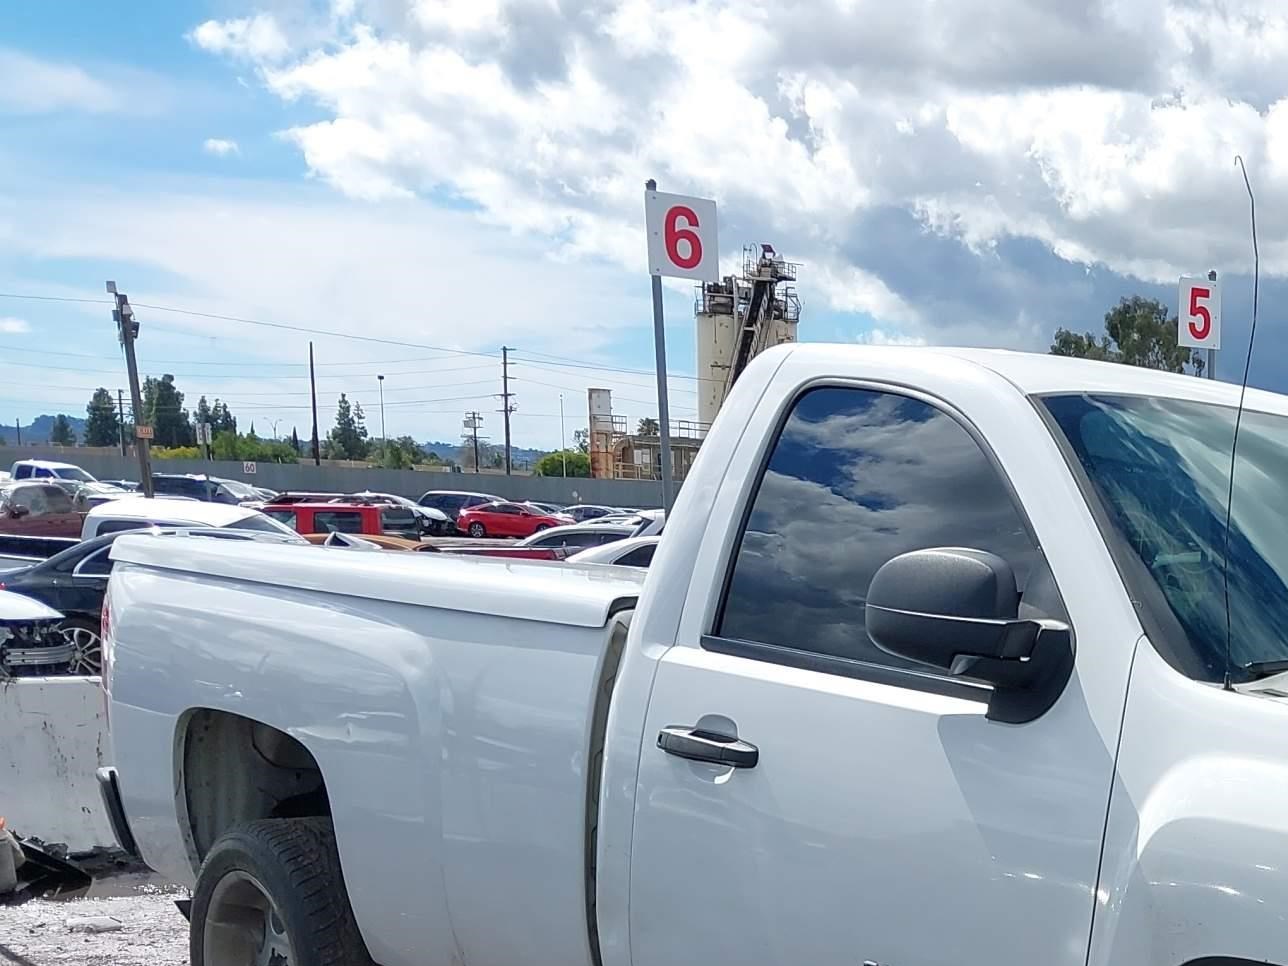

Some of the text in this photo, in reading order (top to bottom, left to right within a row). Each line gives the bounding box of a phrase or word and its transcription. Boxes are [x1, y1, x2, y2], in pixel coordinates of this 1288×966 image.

[664, 205, 703, 270] 6
[1188, 286, 1211, 340] 5
[245, 462, 255, 473] 60
